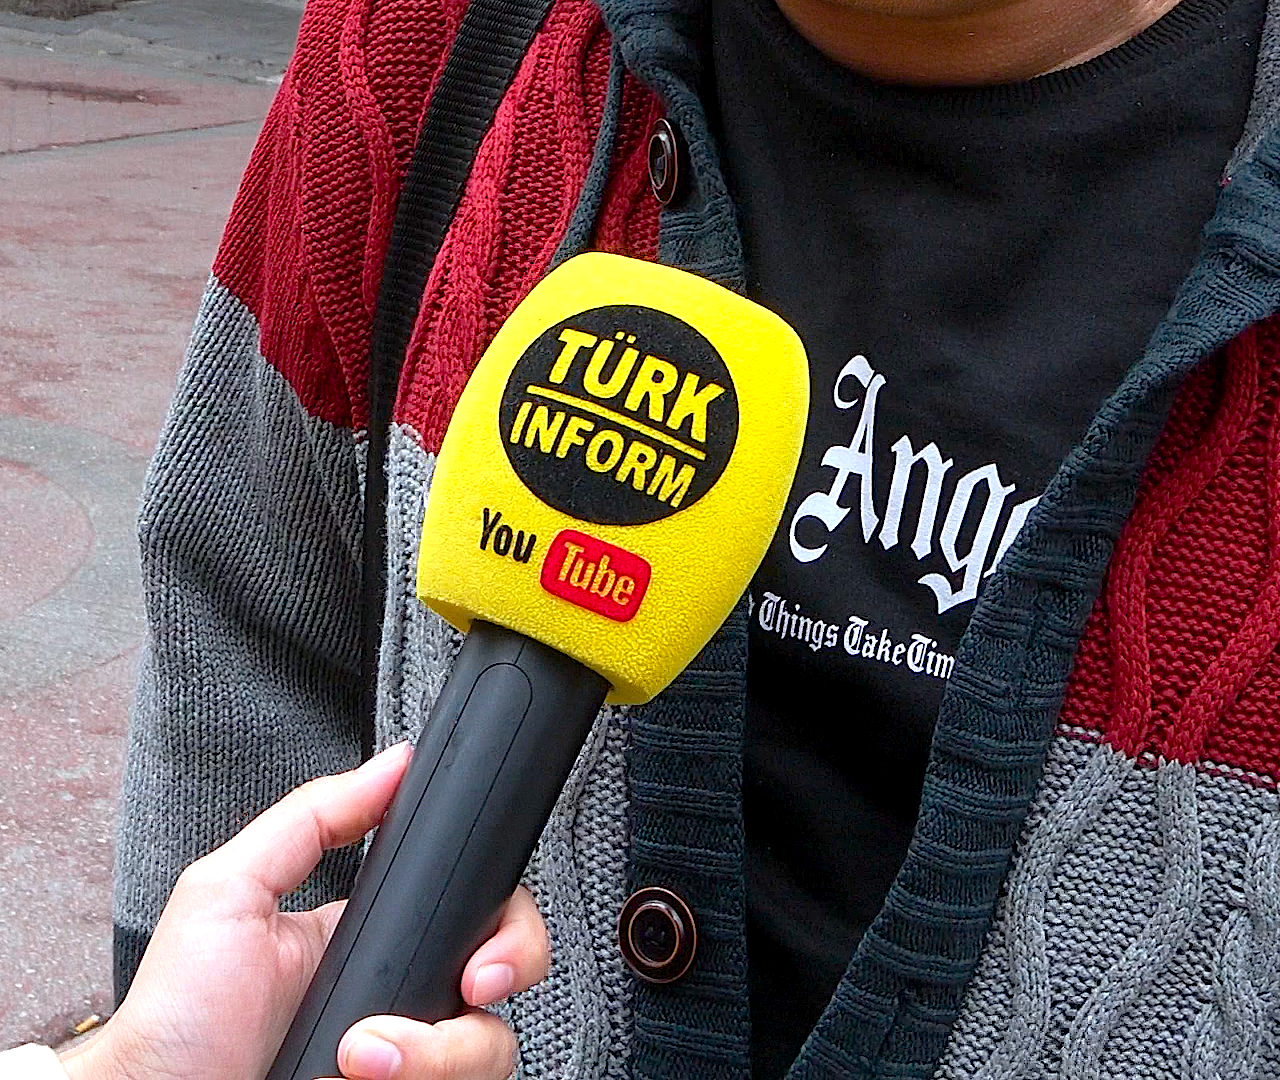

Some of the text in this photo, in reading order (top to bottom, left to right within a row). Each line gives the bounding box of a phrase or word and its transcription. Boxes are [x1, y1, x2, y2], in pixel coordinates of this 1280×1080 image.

[549, 328, 725, 443] TÜRK
[510, 401, 696, 508] INFORM
[480, 507, 635, 606] You Tube
[758, 591, 839, 652] Things
[843, 615, 907, 666] Take
[907, 633, 955, 680] Tim
